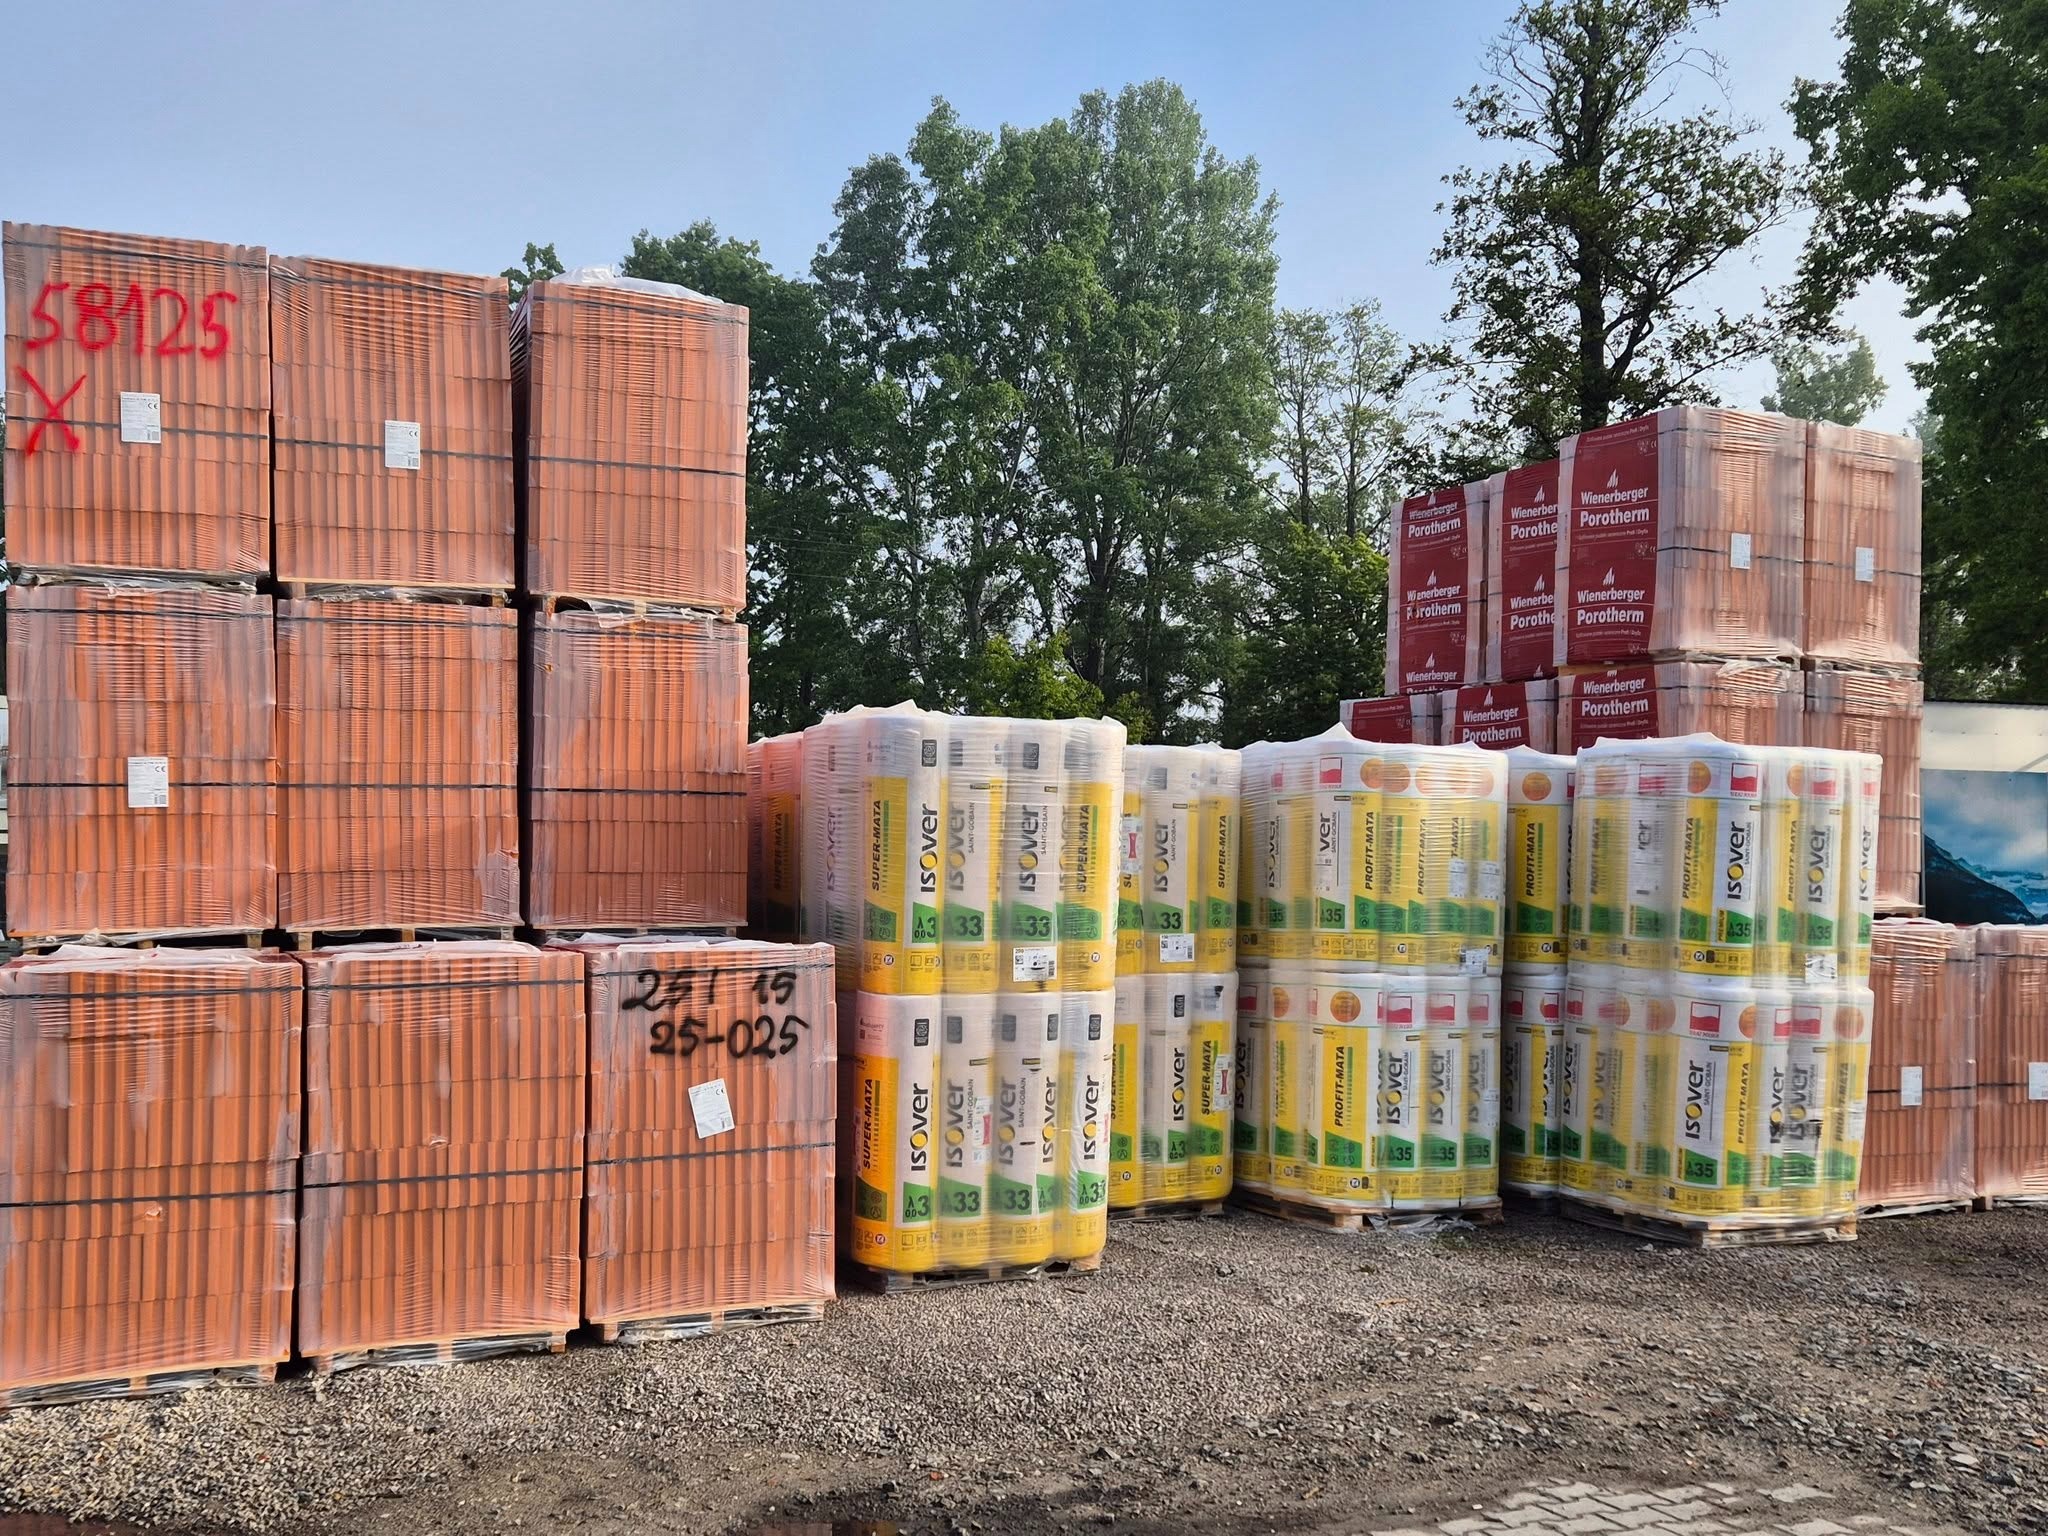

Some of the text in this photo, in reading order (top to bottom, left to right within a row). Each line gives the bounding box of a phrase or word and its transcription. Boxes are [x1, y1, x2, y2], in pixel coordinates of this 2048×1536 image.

[24, 282, 238, 362] 58125
[1580, 487, 1649, 505] Wienerberger
[1511, 503, 1557, 519] Wienerber
[1580, 508, 1649, 527] Porotherm
[1408, 517, 1461, 538] Porotherm
[1510, 521, 1557, 540] Porothe
[1510, 594, 1554, 610] Wienerbe
[1577, 588, 1645, 604] Wienerberger
[1510, 612, 1555, 630] Porothe
[1577, 607, 1645, 626] Porotherm
[1406, 670, 1457, 683] Wienerberger
[1583, 678, 1646, 694] Wienerberger
[1463, 707, 1519, 723] Wienerberger
[1581, 698, 1649, 717] Porotherm
[1462, 726, 1522, 743] Porotherm
[871, 800, 882, 891] SUPER-MATA
[1077, 804, 1090, 893] SUPER-MATA
[1450, 816, 1459, 858] T-MATA
[1217, 815, 1227, 889] SUPER-MATA
[1364, 811, 1374, 890] PROFIT-MATA
[1525, 822, 1535, 897] PROFIT-MATA
[1682, 817, 1694, 900] PROFIT-MATA
[1787, 820, 1798, 901] PROFIT-MATA
[1160, 911, 1182, 930] 33
[1326, 908, 1342, 923] 35
[650, 1015, 809, 1059] 25-025
[1202, 1040, 1212, 1115] SUPER-MATA
[1334, 1046, 1345, 1127] PROFIT-MATA
[1704, 1061, 1713, 1106] SAINT-GOBAIN
[966, 1078, 974, 1130] SAINT-GOBAIN
[1018, 1077, 1026, 1128] SAINT-GOBAIN
[1738, 1062, 1750, 1144] PROFIT-MATA
[863, 1078, 873, 1170] SUPER-MATA
[1395, 1146, 1412, 1161] 35
[1694, 1159, 1714, 1178] 35
[954, 1190, 980, 1213] 33
[1004, 1188, 1030, 1211] 33
